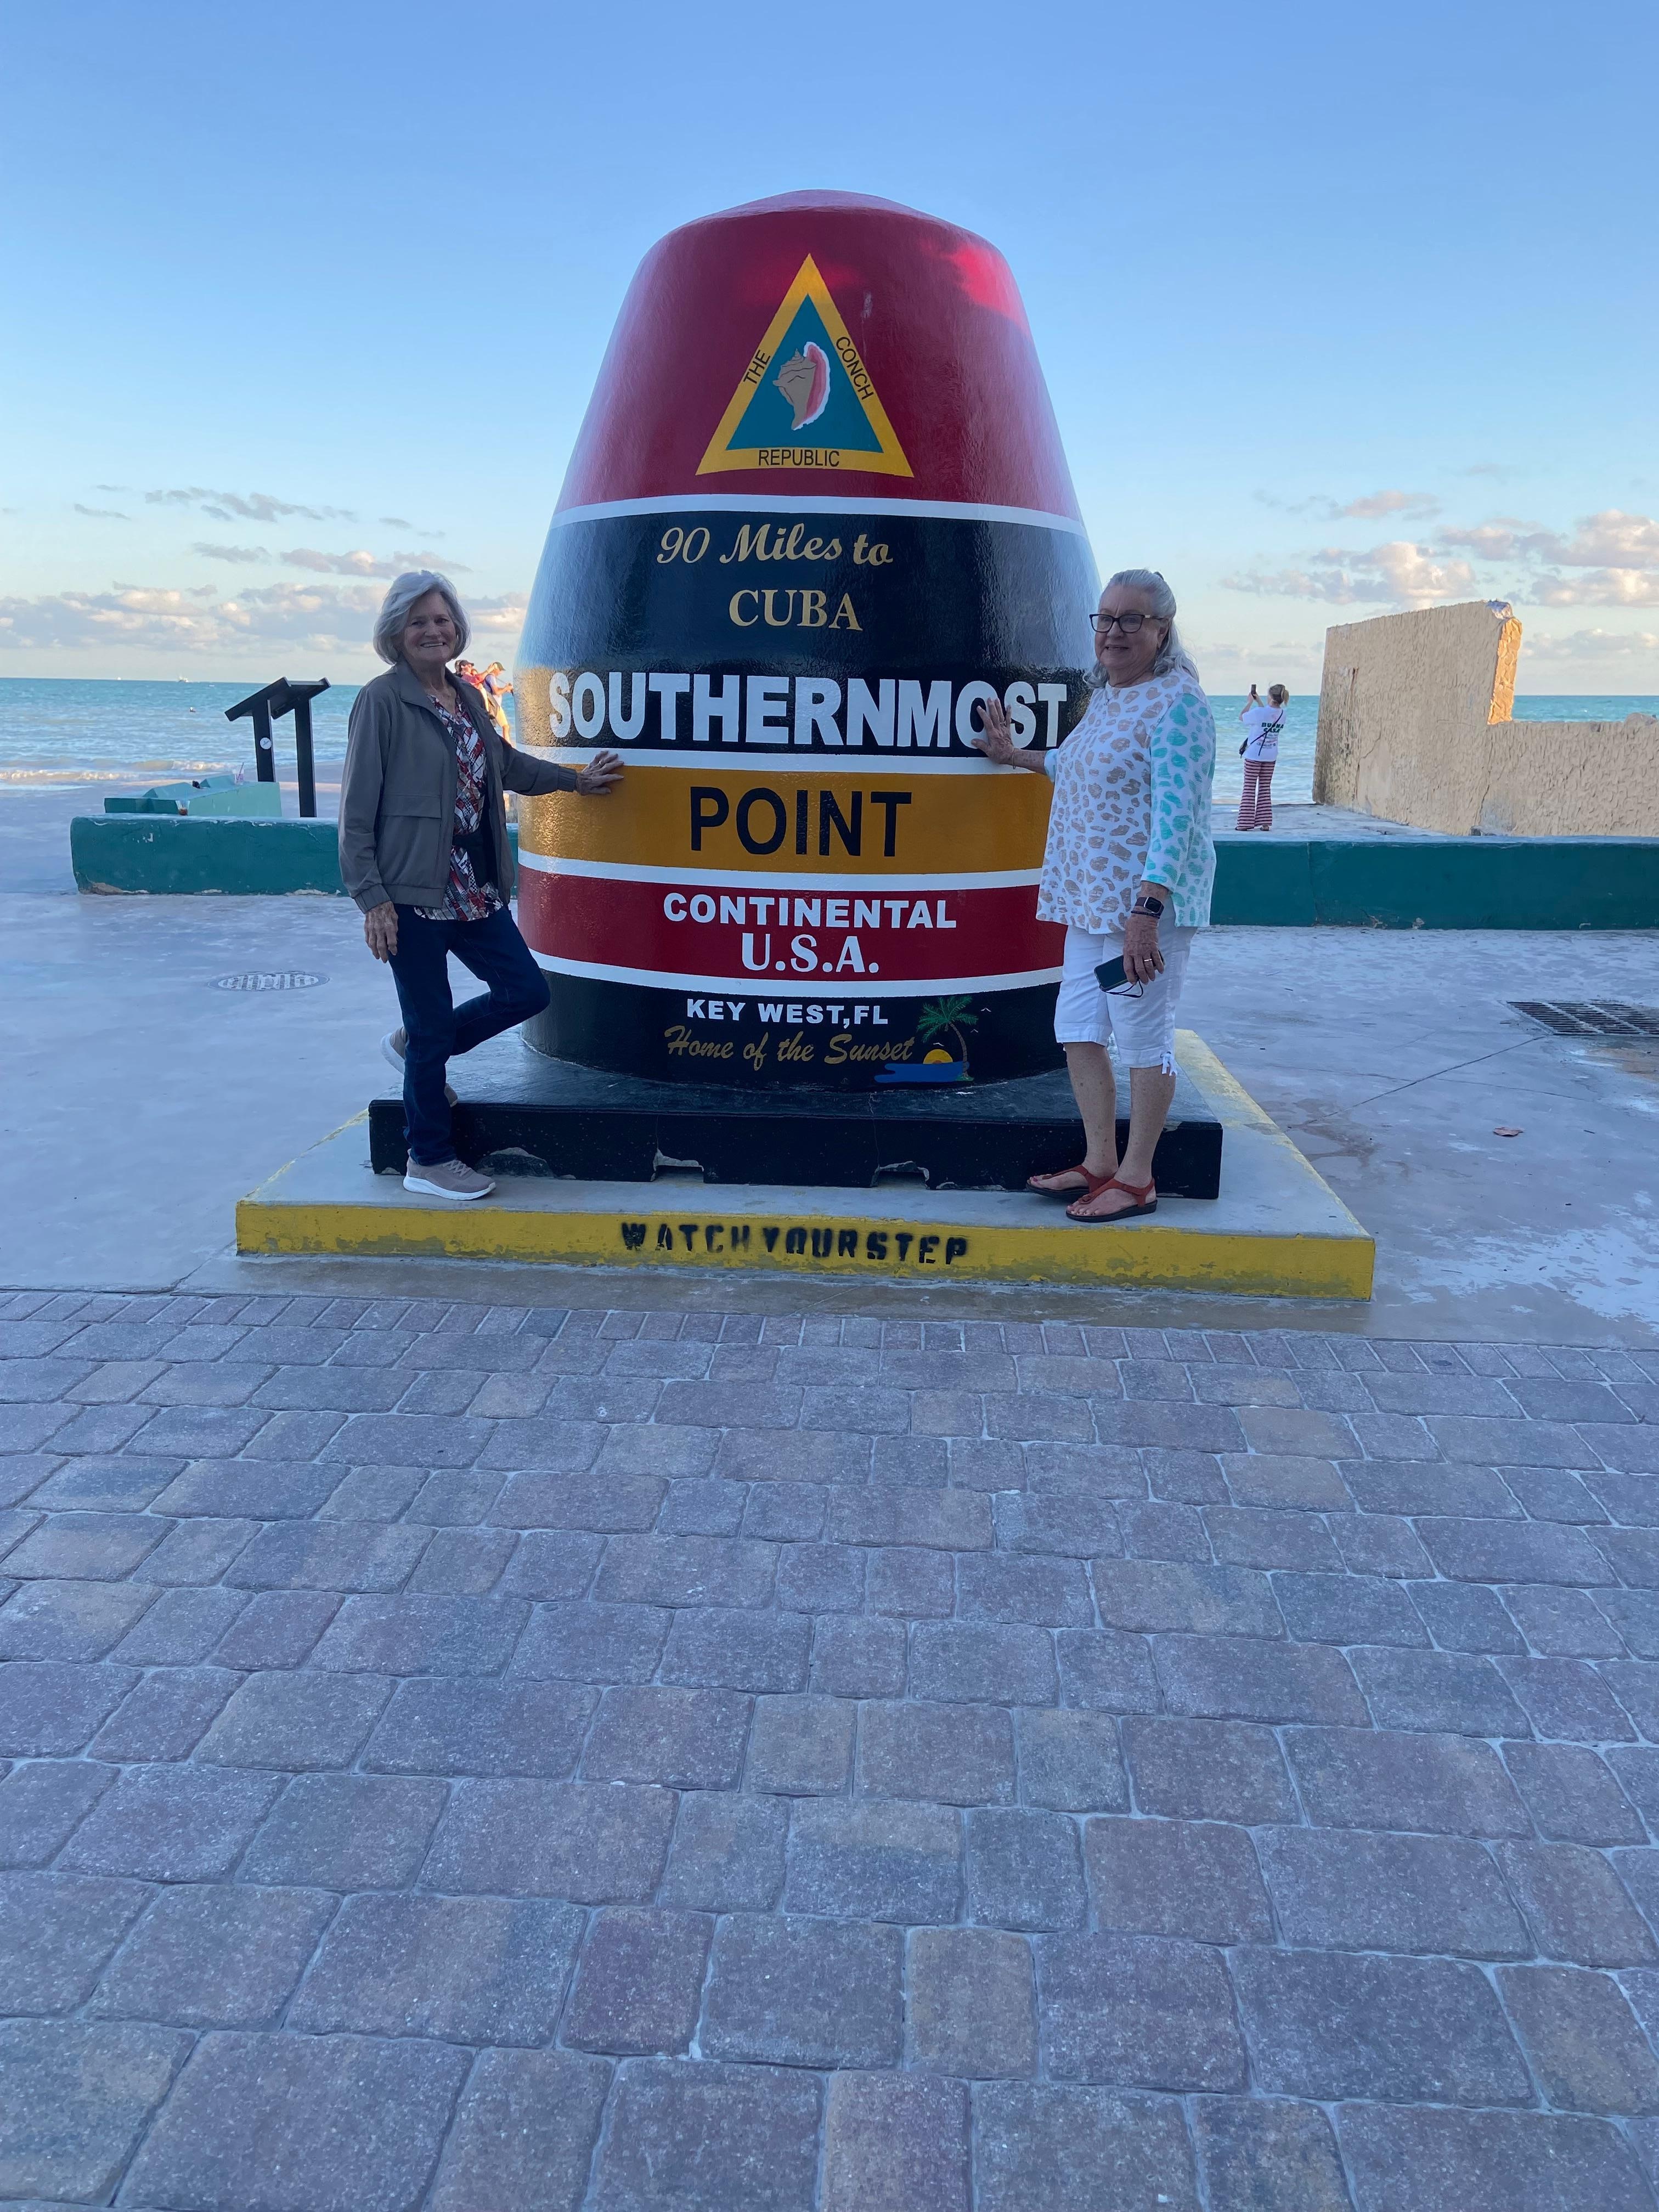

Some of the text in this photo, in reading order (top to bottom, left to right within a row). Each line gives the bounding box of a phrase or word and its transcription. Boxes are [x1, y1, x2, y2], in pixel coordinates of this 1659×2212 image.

[743, 349, 771, 384] THE
[836, 336, 874, 400] CONCH
[758, 449, 840, 467] REPUBLIC
[657, 523, 893, 566] 90 Miles to
[729, 589, 863, 631] CUBA
[549, 672, 1068, 749] SOUTHERNMOST
[690, 786, 912, 857] POINT
[663, 893, 957, 928] CONTINENTAL
[742, 933, 879, 973] U.S.A.
[687, 998, 746, 1020] KEY
[664, 1025, 915, 1071] Home of the Sunset
